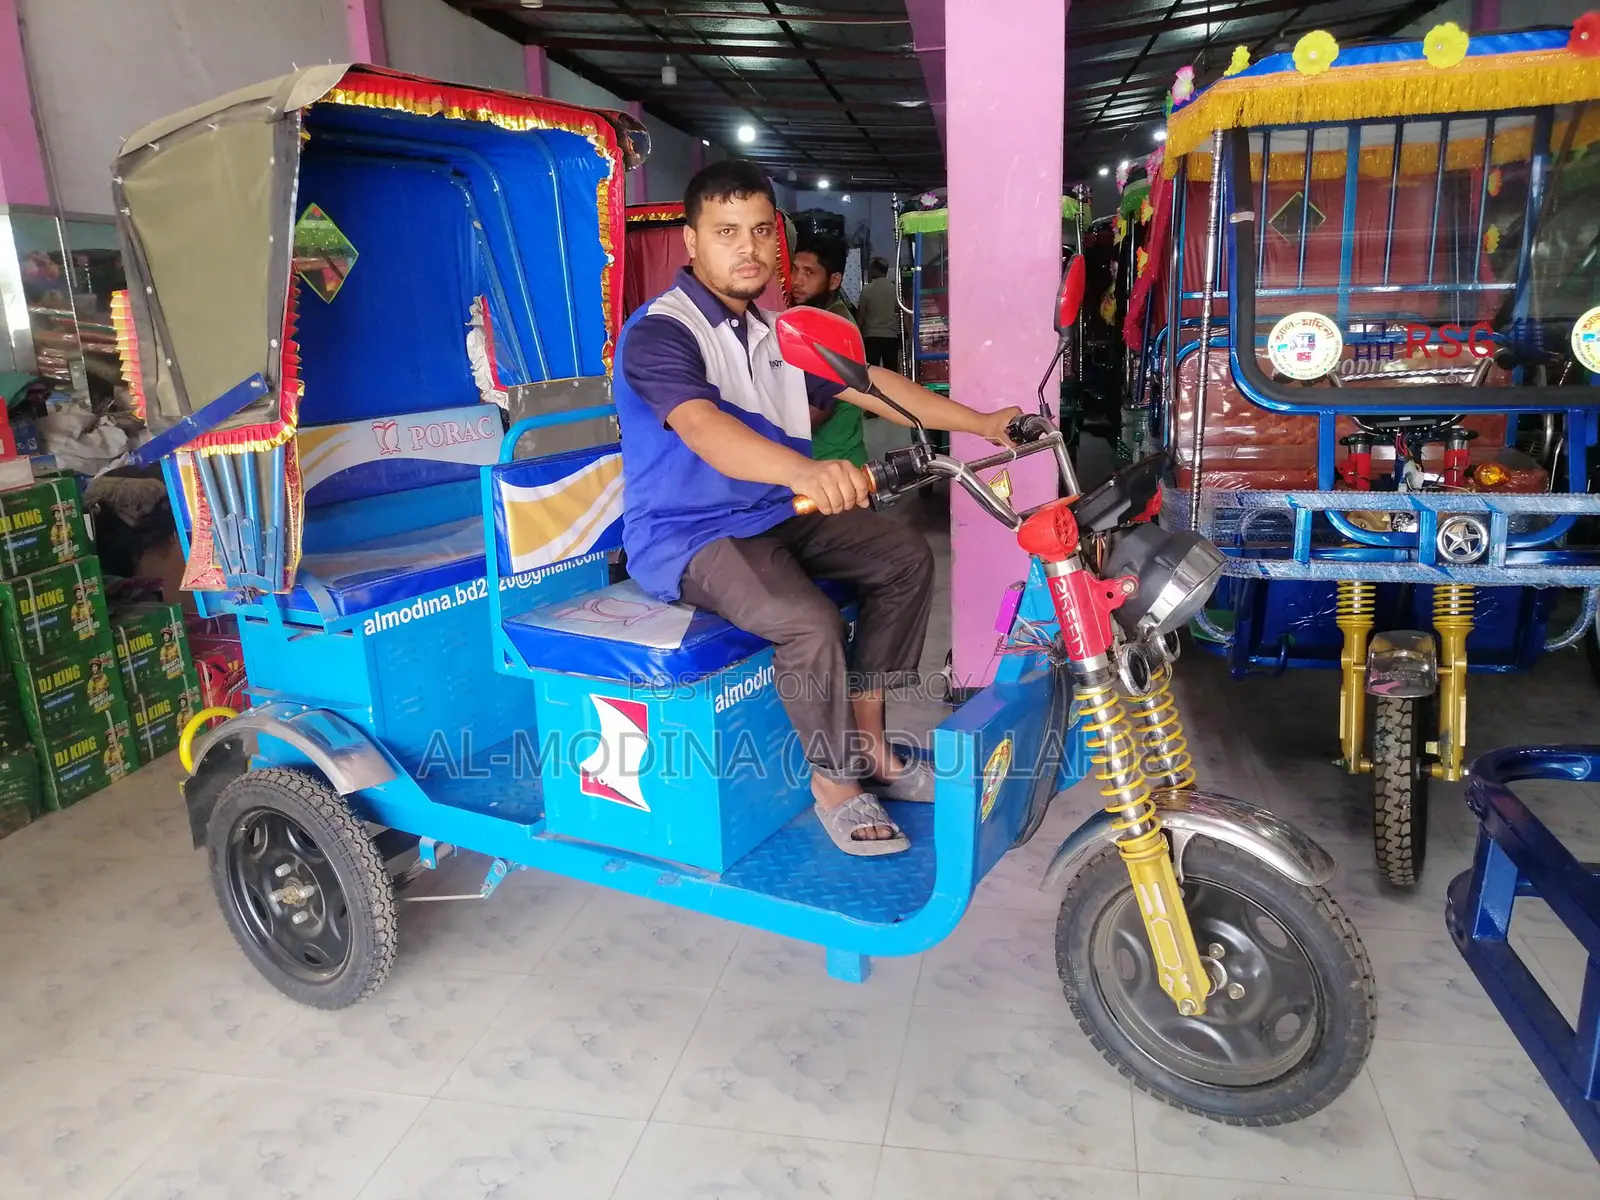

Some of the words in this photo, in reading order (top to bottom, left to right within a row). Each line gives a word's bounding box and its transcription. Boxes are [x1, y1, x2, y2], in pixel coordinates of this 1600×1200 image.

[1406, 322, 1495, 359] RSG
[408, 416, 495, 451] PORAC
[13, 508, 43, 530] KING
[36, 588, 65, 610] KING
[363, 551, 605, 637] almodina.bd220@gmail.com
[129, 632, 154, 653] KING
[38, 674, 52, 694] DJ
[53, 664, 81, 689] KING
[148, 698, 172, 721] KING
[54, 748, 69, 769] DJ
[70, 735, 97, 760] KING
